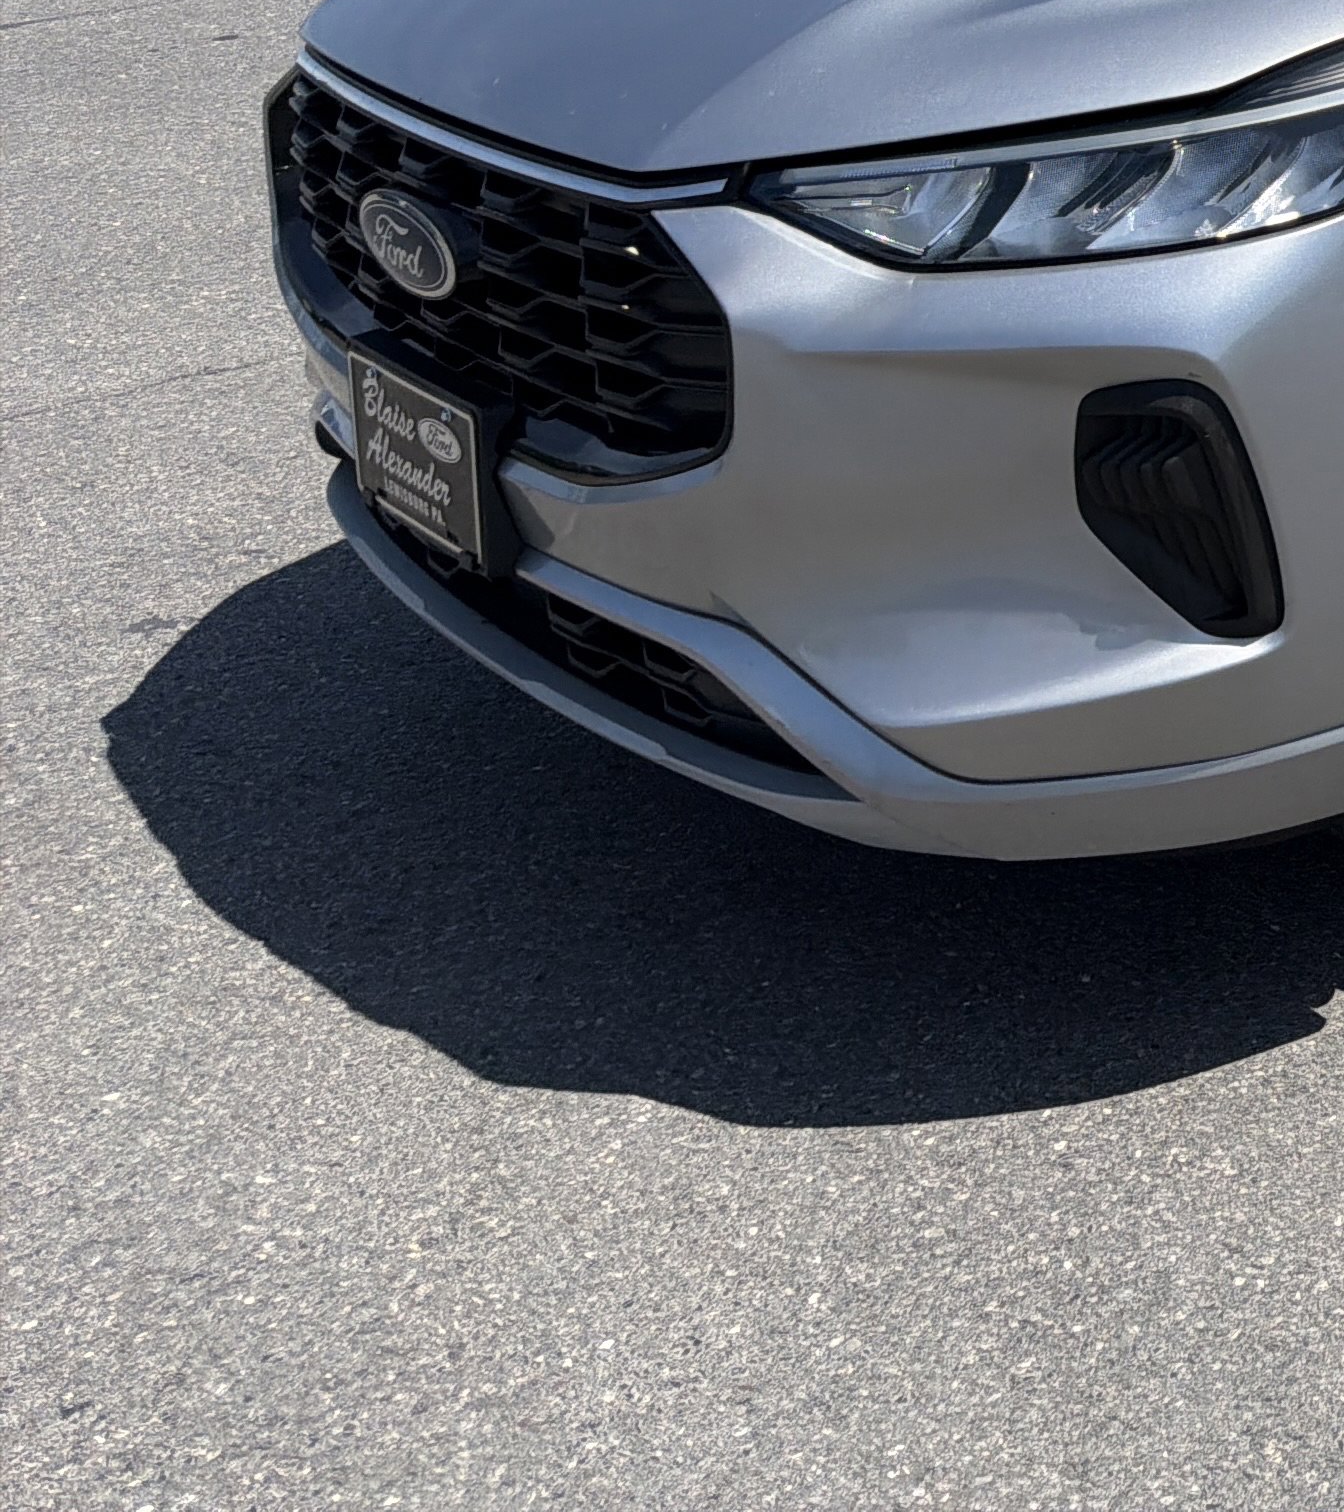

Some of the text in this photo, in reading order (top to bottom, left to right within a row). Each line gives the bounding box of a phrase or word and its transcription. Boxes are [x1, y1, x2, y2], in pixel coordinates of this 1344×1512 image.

[373, 214, 423, 278] Ford
[362, 374, 416, 441] Blaise
[366, 427, 451, 506] Alexander
